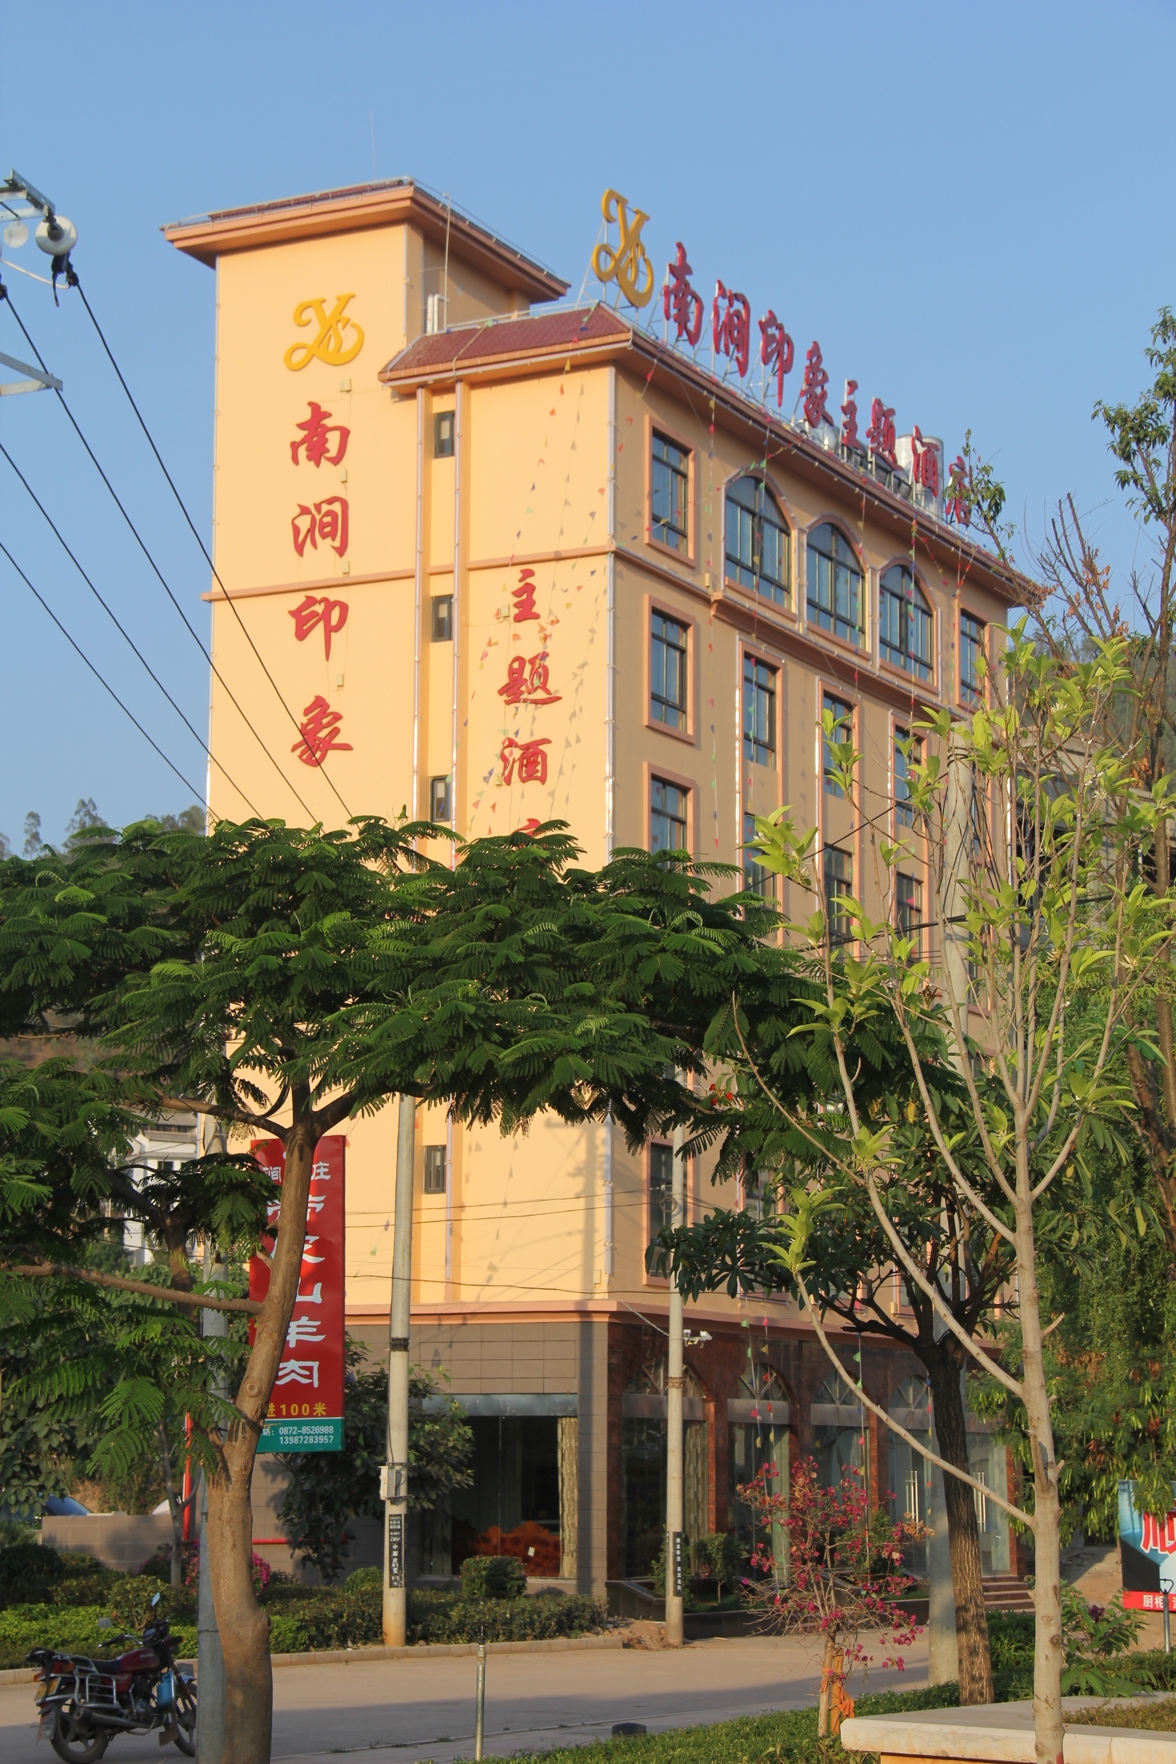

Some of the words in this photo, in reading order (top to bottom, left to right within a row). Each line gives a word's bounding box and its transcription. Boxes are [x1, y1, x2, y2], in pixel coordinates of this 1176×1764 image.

[290, 401, 353, 768] 南涧印象
[278, 1425, 334, 1436] 0872-8526988
[279, 1435, 334, 1445] 13987283957
